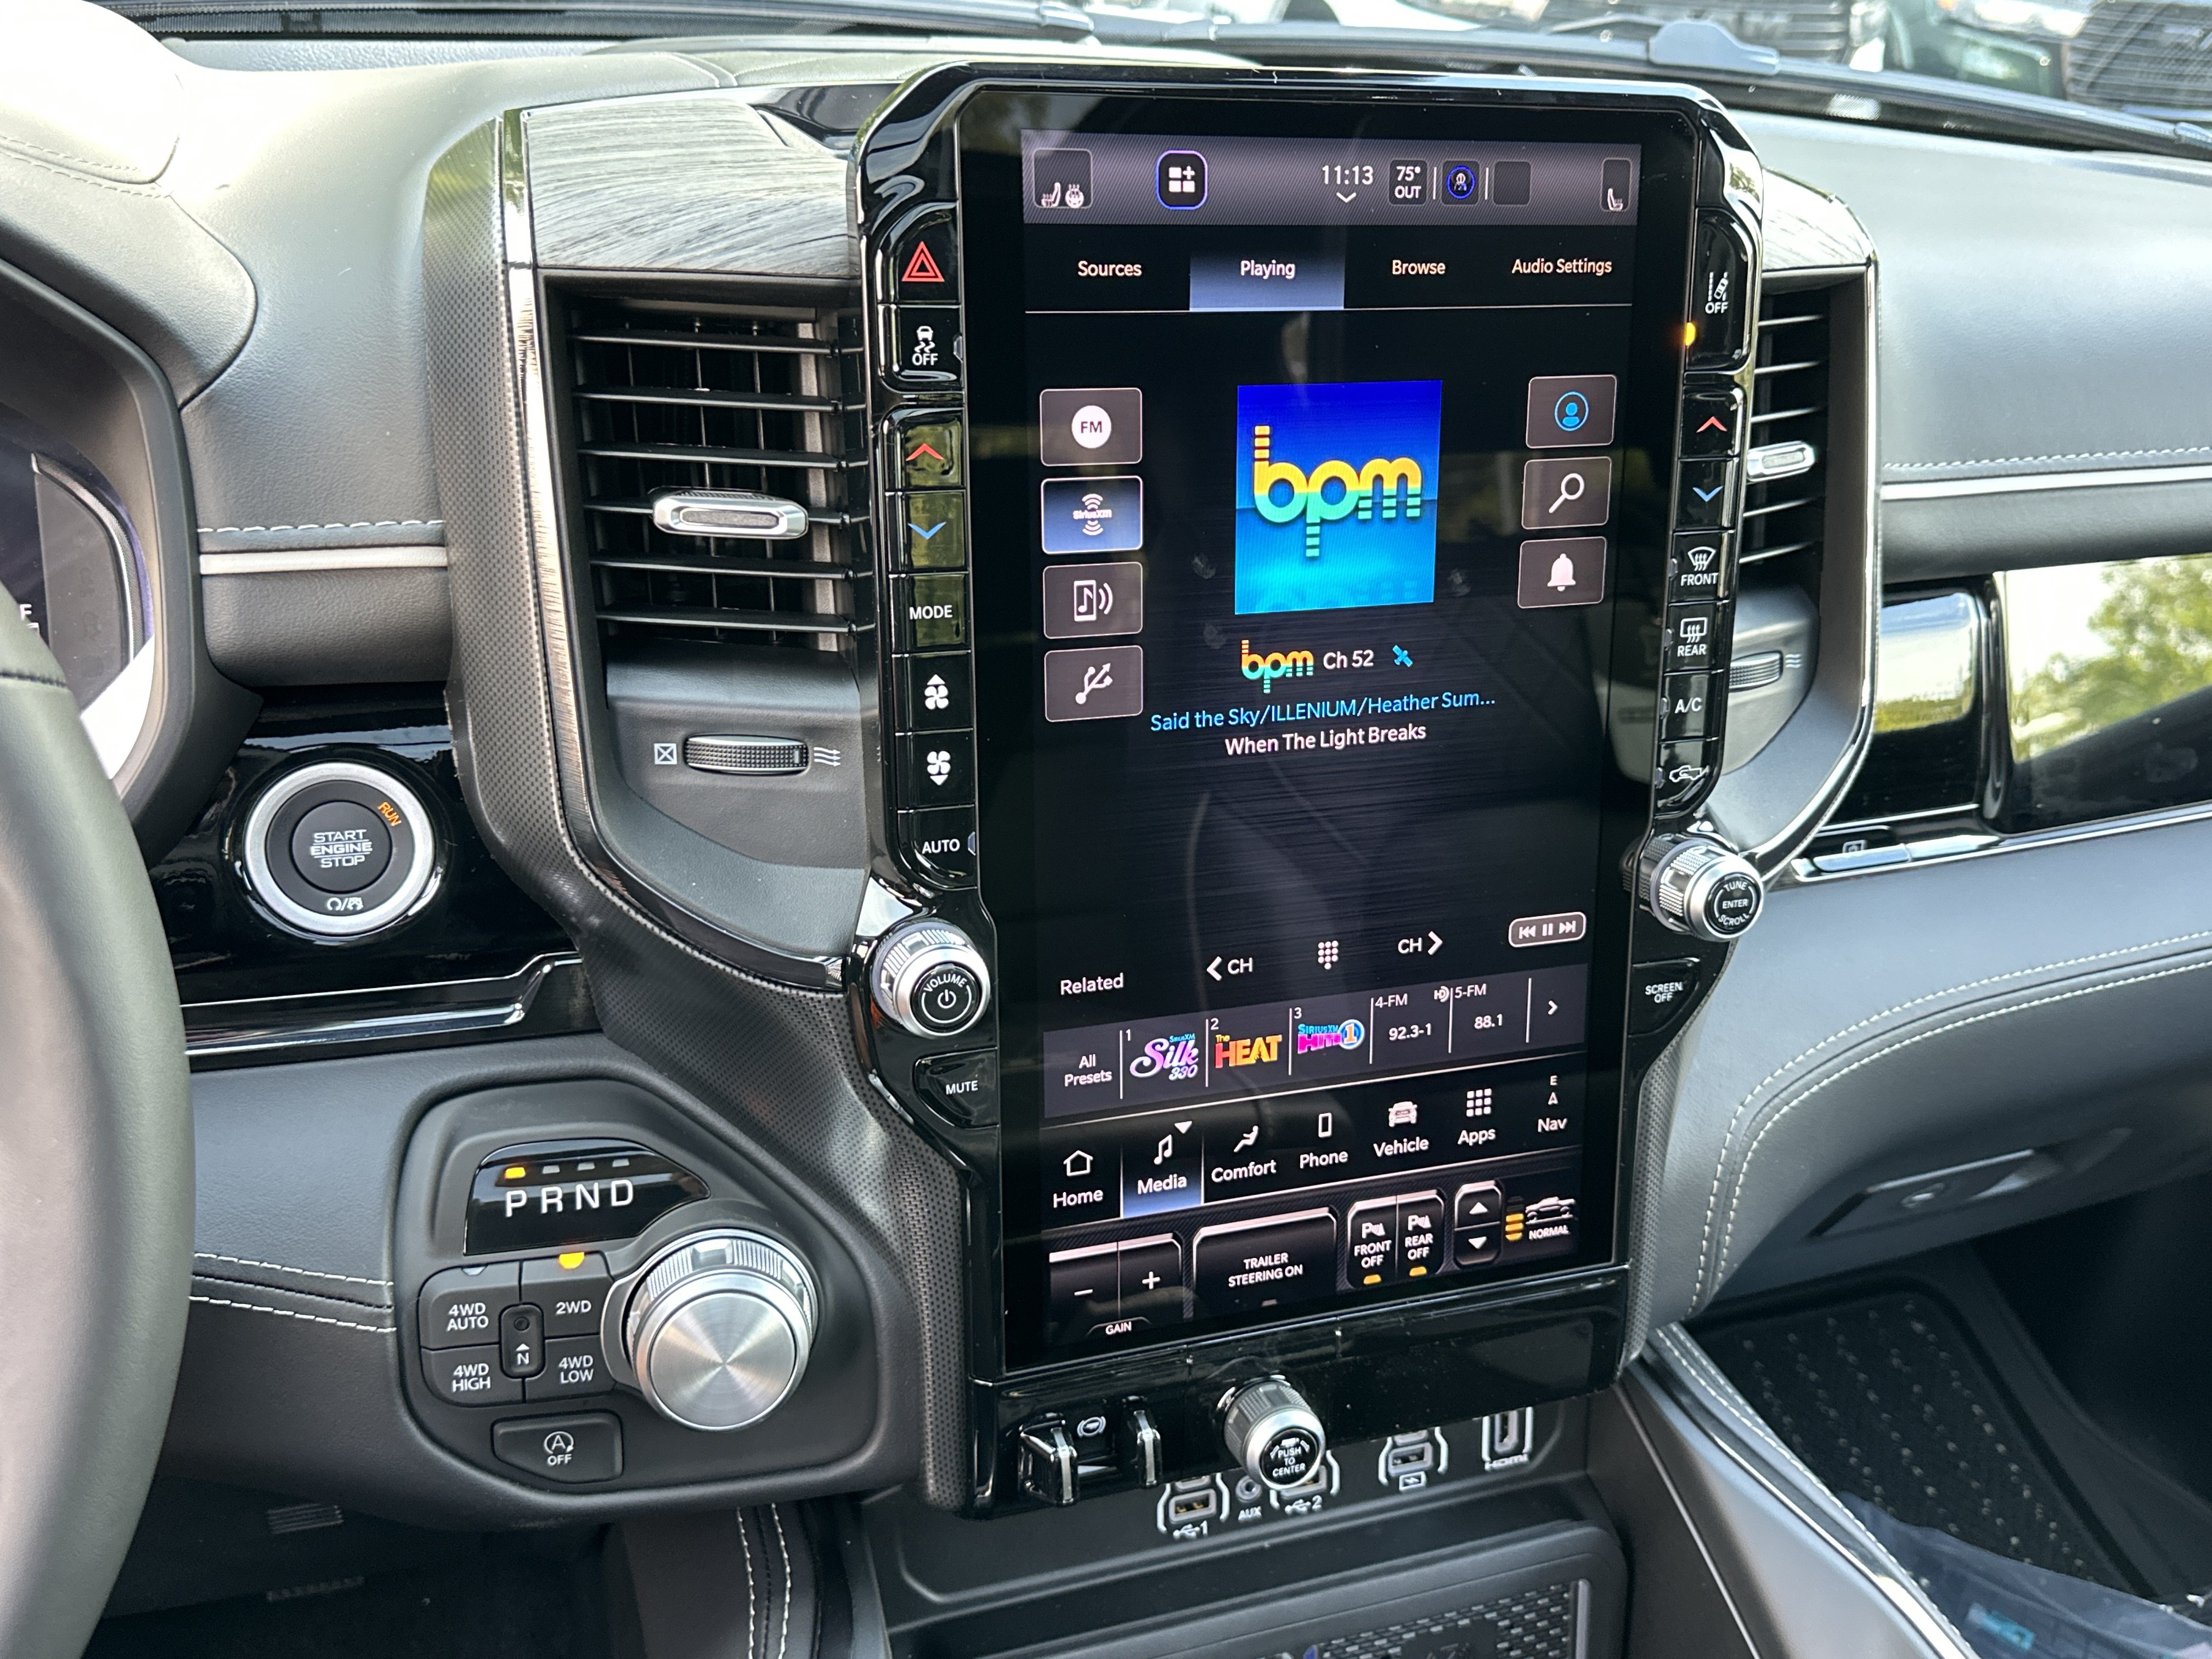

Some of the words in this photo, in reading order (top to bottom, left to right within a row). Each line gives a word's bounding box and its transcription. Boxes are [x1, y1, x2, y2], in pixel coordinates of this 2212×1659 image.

[1322, 165, 1374, 185] 11:13
[1396, 166, 1421, 181] 75°
[1394, 185, 1421, 199] OUT
[1077, 260, 1142, 276] Sources
[1240, 259, 1296, 279] Playing
[1392, 259, 1446, 275] Browse
[1511, 258, 1553, 274] Audio
[1556, 258, 1612, 276] Settings
[1705, 301, 1729, 314] OFF
[911, 352, 939, 366] OFF
[1080, 420, 1103, 434] FM
[1253, 424, 1422, 558] bpm
[1680, 572, 1719, 587] FRONT
[909, 604, 953, 620] MODE
[1677, 644, 1707, 657] REAR
[1242, 639, 1314, 693] bpm
[1323, 651, 1348, 670] Ch
[1351, 649, 1374, 668] 52
[1150, 711, 1189, 732] Said
[1194, 710, 1224, 727] the
[1228, 693, 1439, 727] Sky/ILLENIUM/Heather
[1441, 692, 1496, 708] Sum...
[1674, 697, 1703, 714] A/C
[1224, 736, 1279, 756] When
[1282, 732, 1316, 751] The
[1320, 728, 1365, 751] Light
[1368, 723, 1426, 744] Breaks
[377, 801, 402, 827] RUN
[313, 828, 367, 843] START
[310, 841, 373, 856] ENGINE
[921, 838, 961, 855] AUTO
[320, 855, 366, 868] STOP
[1723, 881, 1749, 891] TUNE
[1722, 898, 1749, 910] ENTER
[1717, 912, 1751, 927] SCROLL
[1397, 936, 1423, 954] CH
[1227, 957, 1253, 975] CH
[923, 973, 968, 992] VOLUME
[1060, 972, 1124, 996] Related
[1645, 981, 1683, 996] SCREEN
[1454, 983, 1487, 999] 5-FM
[1654, 991, 1673, 1004] OFF
[1374, 992, 1408, 1008] 4-FM
[1294, 1007, 1302, 1019] 3
[1210, 1018, 1220, 1030] 2
[1474, 1013, 1503, 1030] 88.1
[1125, 1029, 1132, 1041] 1
[1215, 1034, 1231, 1043] The
[1389, 1023, 1432, 1041] 92.3-1
[1130, 1037, 1199, 1078] Silk
[1215, 1034, 1283, 1069] HEAT
[1079, 1054, 1096, 1069] All
[1064, 1069, 1113, 1087] Presets
[1168, 1064, 1199, 1081] 330
[1549, 1075, 1558, 1086] E
[945, 1080, 979, 1095] MUTE
[1537, 1117, 1568, 1133] Nav
[1457, 1127, 1497, 1147] Apps
[1373, 1136, 1430, 1158] Vehicle
[1299, 1150, 1348, 1169] Phone
[1211, 1159, 1277, 1183] Comfort
[1137, 1173, 1188, 1195] Media
[505, 1189, 527, 1217] P
[540, 1186, 563, 1214] R
[574, 1181, 600, 1211] N
[611, 1178, 634, 1206] D
[1053, 1188, 1104, 1209] Home
[1528, 1224, 1569, 1240] NORMAL
[1354, 1239, 1392, 1257] FRONT
[1404, 1233, 1434, 1248] REAR
[1243, 1252, 1289, 1271] TRAILER
[1361, 1254, 1384, 1269] OFF
[1407, 1246, 1430, 1261] OFF
[1228, 1268, 1283, 1288] STEERING
[1284, 1264, 1304, 1278] ON
[447, 1302, 487, 1317] 4WD
[555, 1300, 592, 1315] 2WD
[446, 1314, 489, 1333] AUTO
[1105, 1321, 1132, 1336] GAIN
[516, 1351, 531, 1366] N
[557, 1355, 594, 1370] 4WD
[453, 1363, 490, 1378] 4WD
[560, 1368, 594, 1385] LOW
[451, 1377, 492, 1392] HIGH
[546, 1453, 573, 1466] OFF
[1278, 1446, 1302, 1458] PUSH
[1284, 1457, 1296, 1466] TO
[1272, 1463, 1306, 1477] CENTER
[1312, 1494, 1323, 1511] 2
[1238, 1505, 1262, 1522] AUX
[1200, 1520, 1208, 1536] 1
